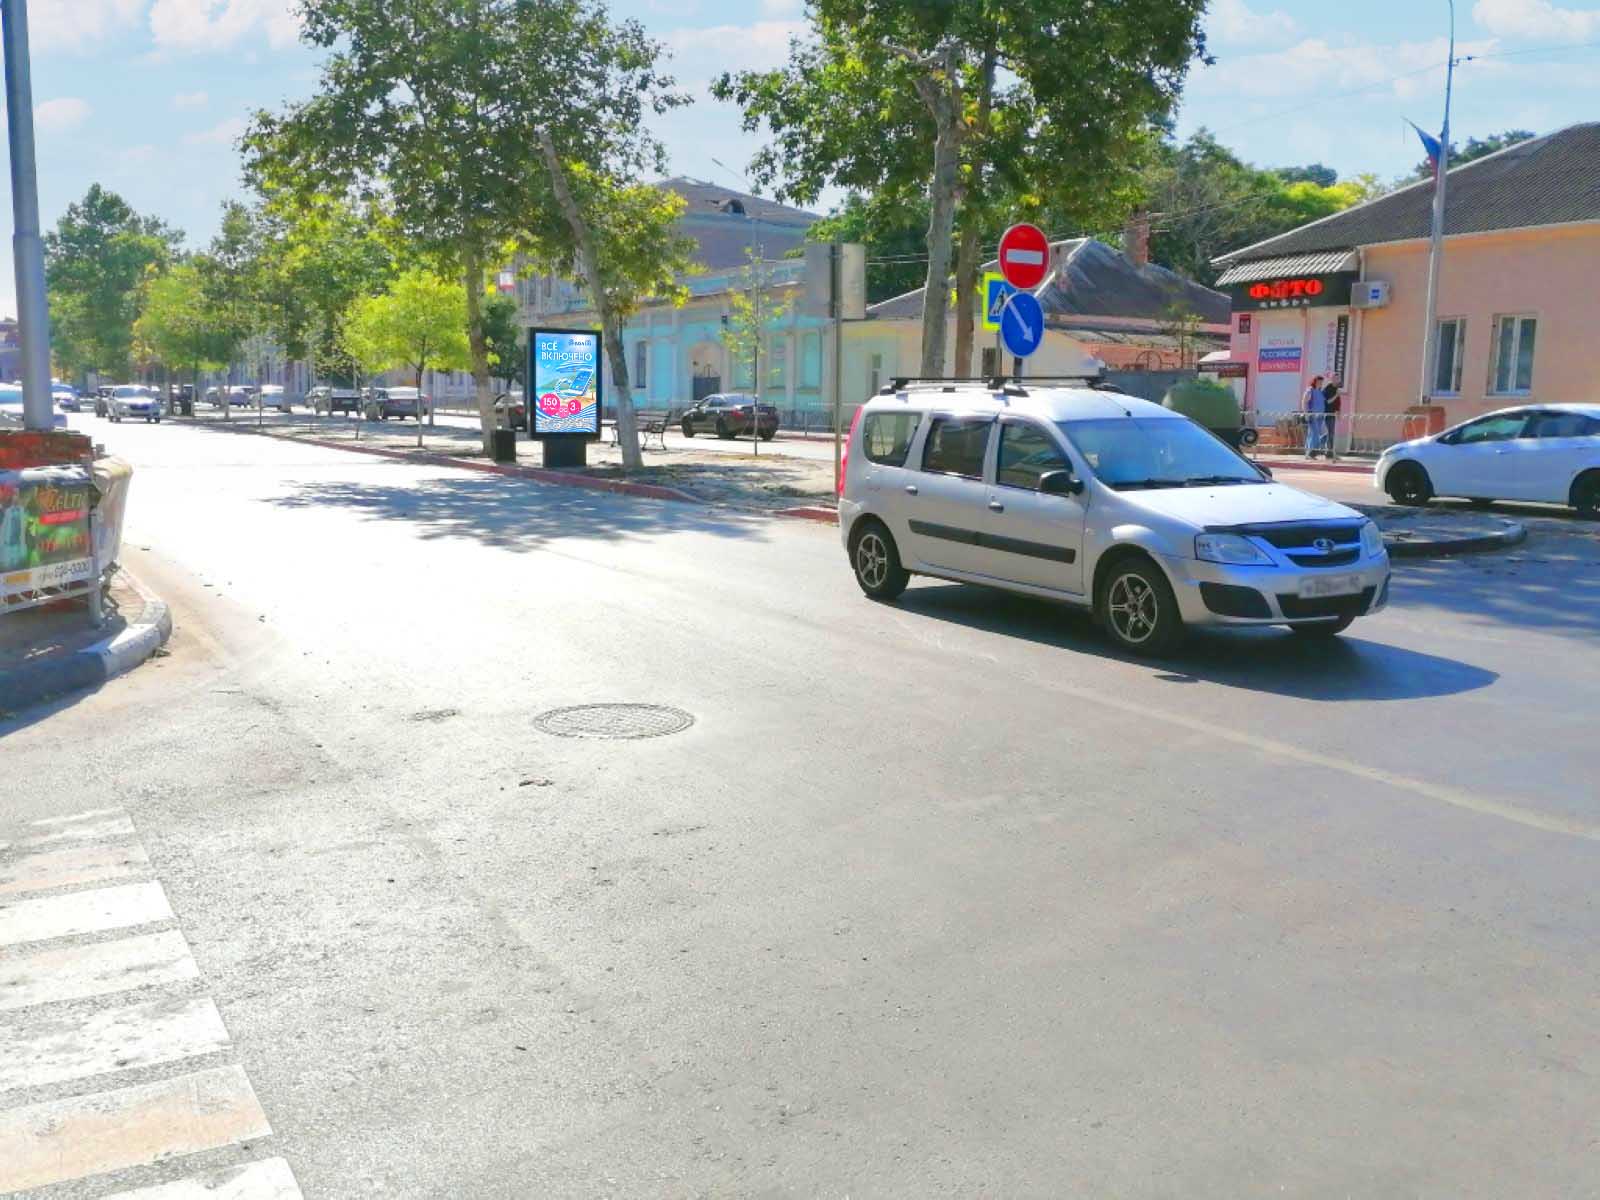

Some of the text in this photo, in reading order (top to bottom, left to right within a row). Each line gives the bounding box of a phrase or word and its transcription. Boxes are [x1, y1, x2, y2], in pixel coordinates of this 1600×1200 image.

[541, 352, 593, 361] ВКЛЮЧЕНО
[543, 397, 558, 406] 150
[570, 402, 576, 411] 3
